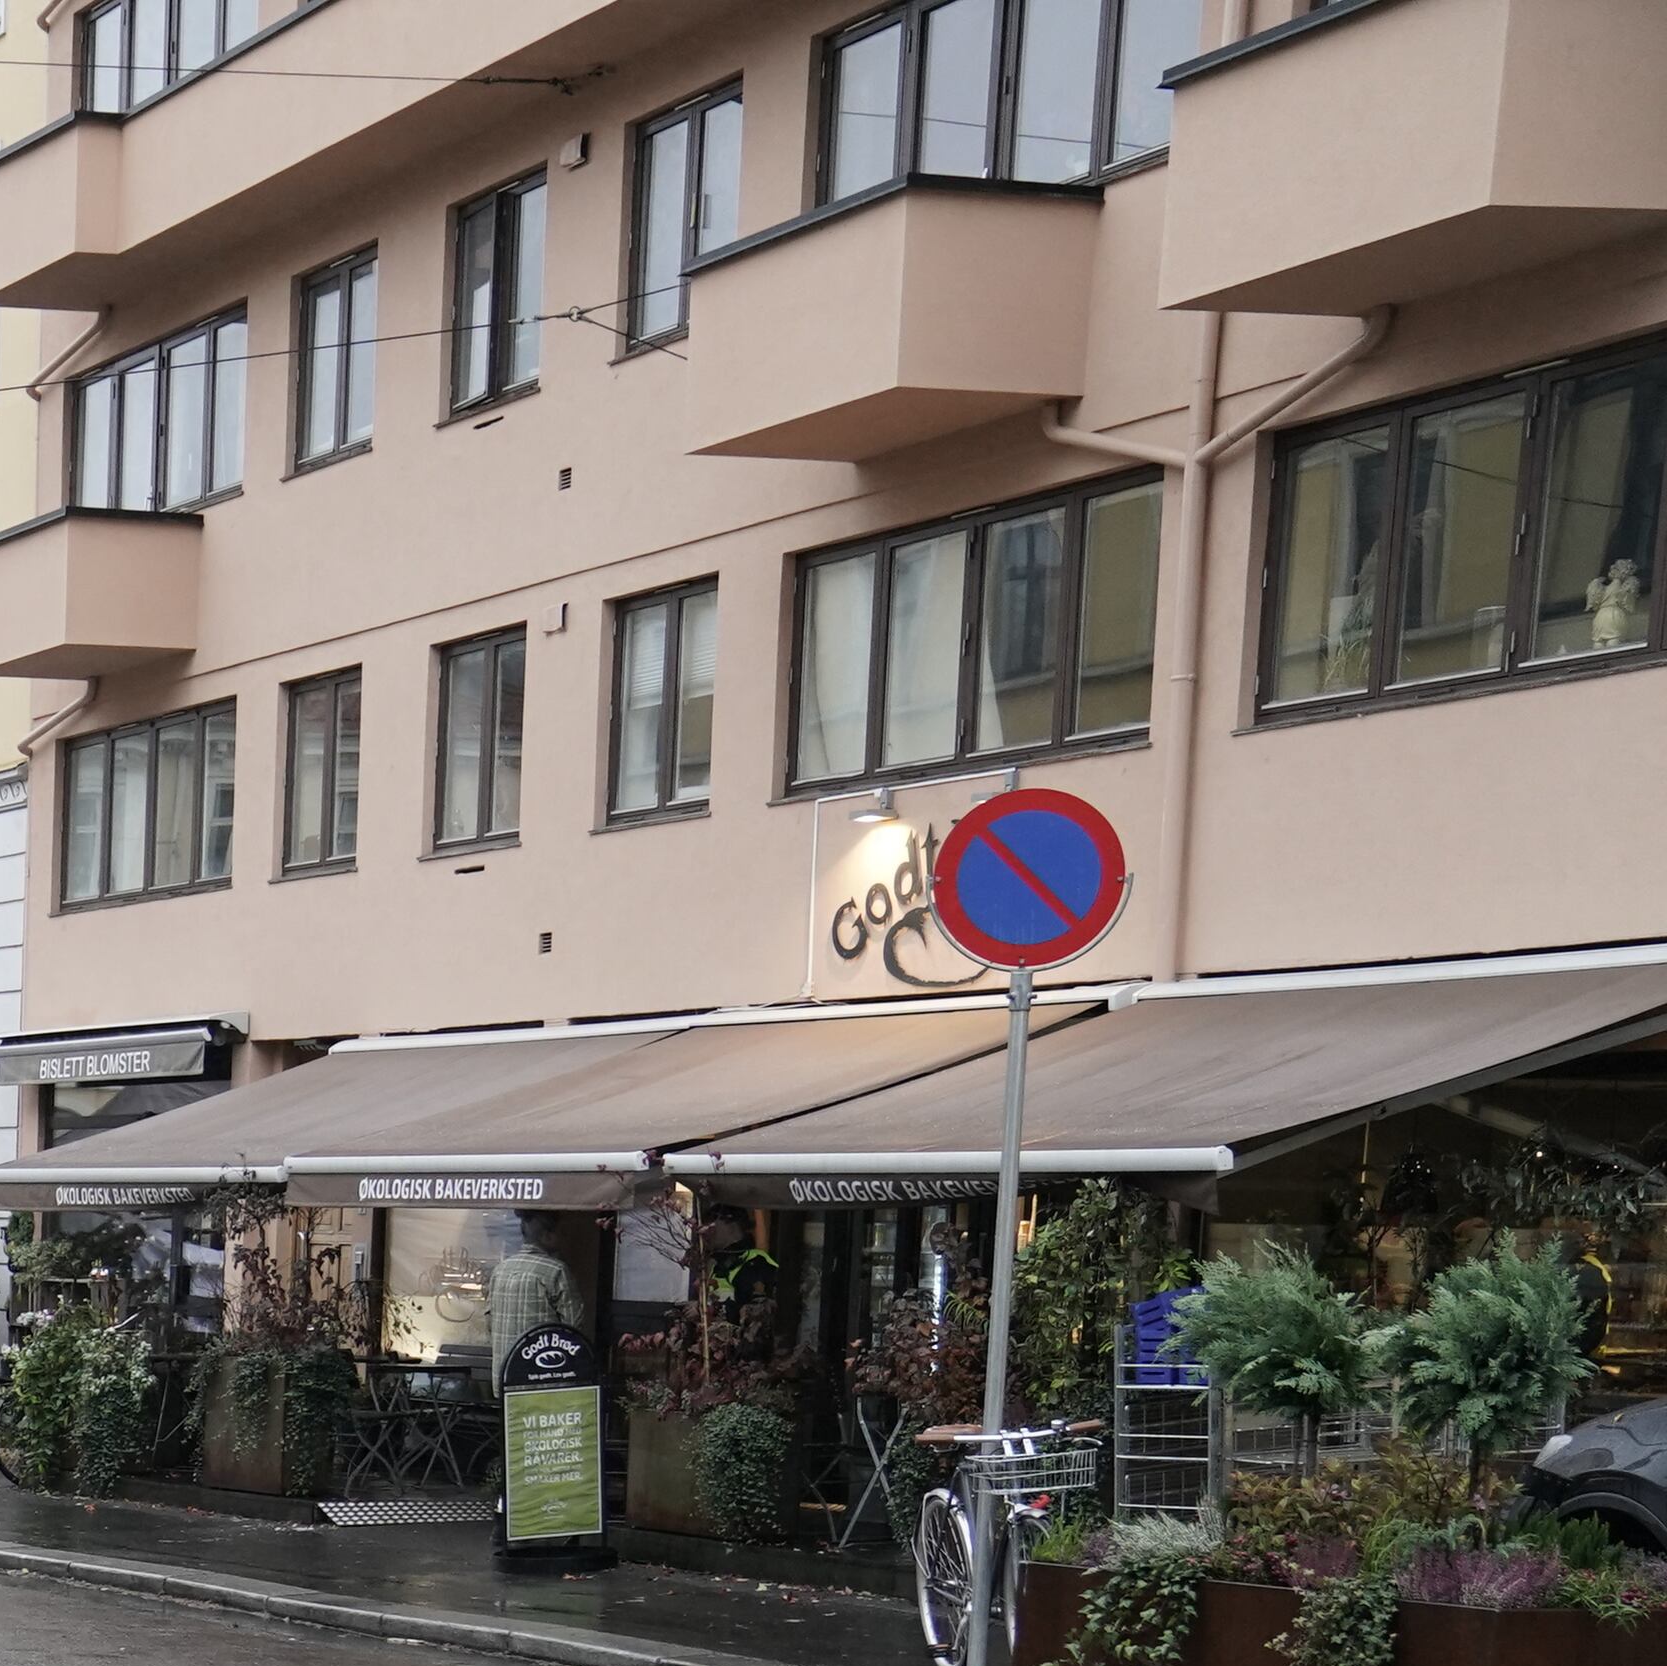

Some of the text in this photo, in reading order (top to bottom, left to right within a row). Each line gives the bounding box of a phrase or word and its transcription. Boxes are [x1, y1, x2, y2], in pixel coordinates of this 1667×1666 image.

[40, 1051, 150, 1079] BISLETT BLOMSTER
[56, 1186, 196, 1206] ØKOLOGISK BAKEVERKSTED
[359, 1177, 543, 1201] ØKOLOGISK BAKEVERKSTED
[788, 1178, 901, 1204] ØKOLOGISK
[521, 1333, 581, 1360] Godt Brød
[523, 1412, 582, 1428] VI BAKER
